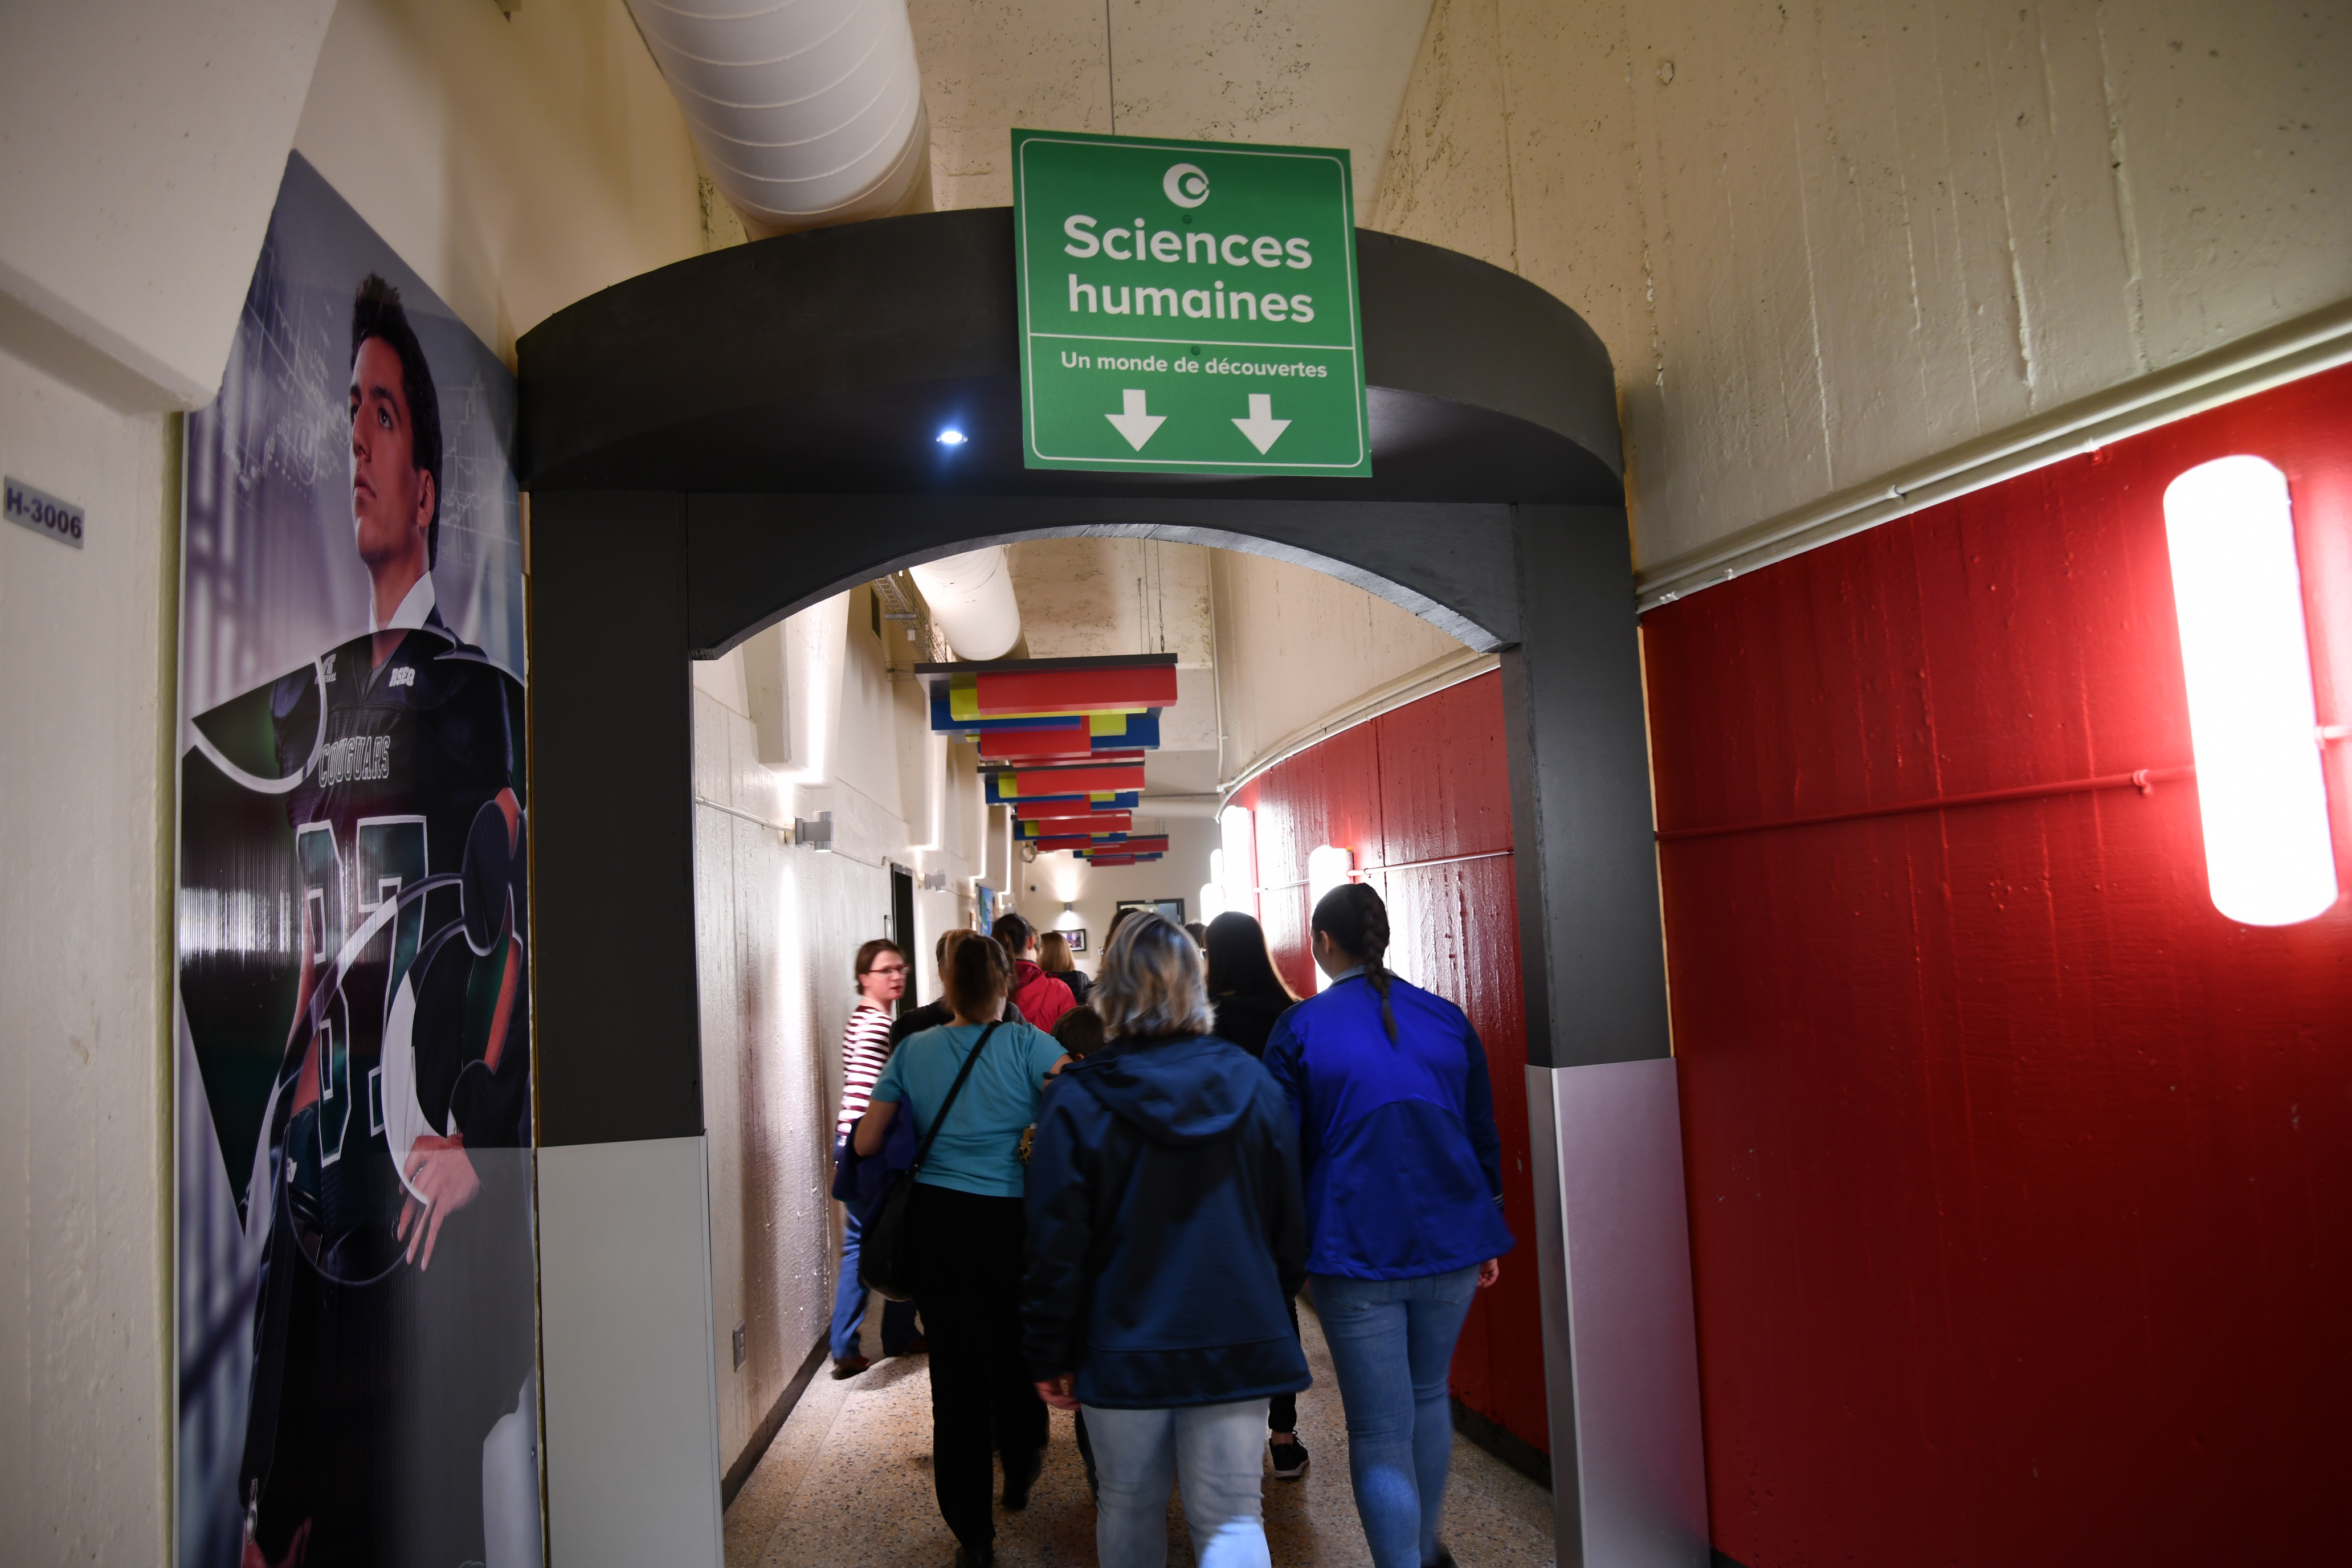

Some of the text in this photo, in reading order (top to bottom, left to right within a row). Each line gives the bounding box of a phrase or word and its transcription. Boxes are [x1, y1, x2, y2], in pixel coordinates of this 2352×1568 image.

[1064, 215, 1312, 270] Sciences
[1068, 273, 1314, 323] humaines
[1061, 351, 1328, 378] Un monde de découvertes
[6, 487, 83, 539] H-3006
[389, 666, 416, 687] RSEQ
[319, 736, 391, 787] COUGUARS
